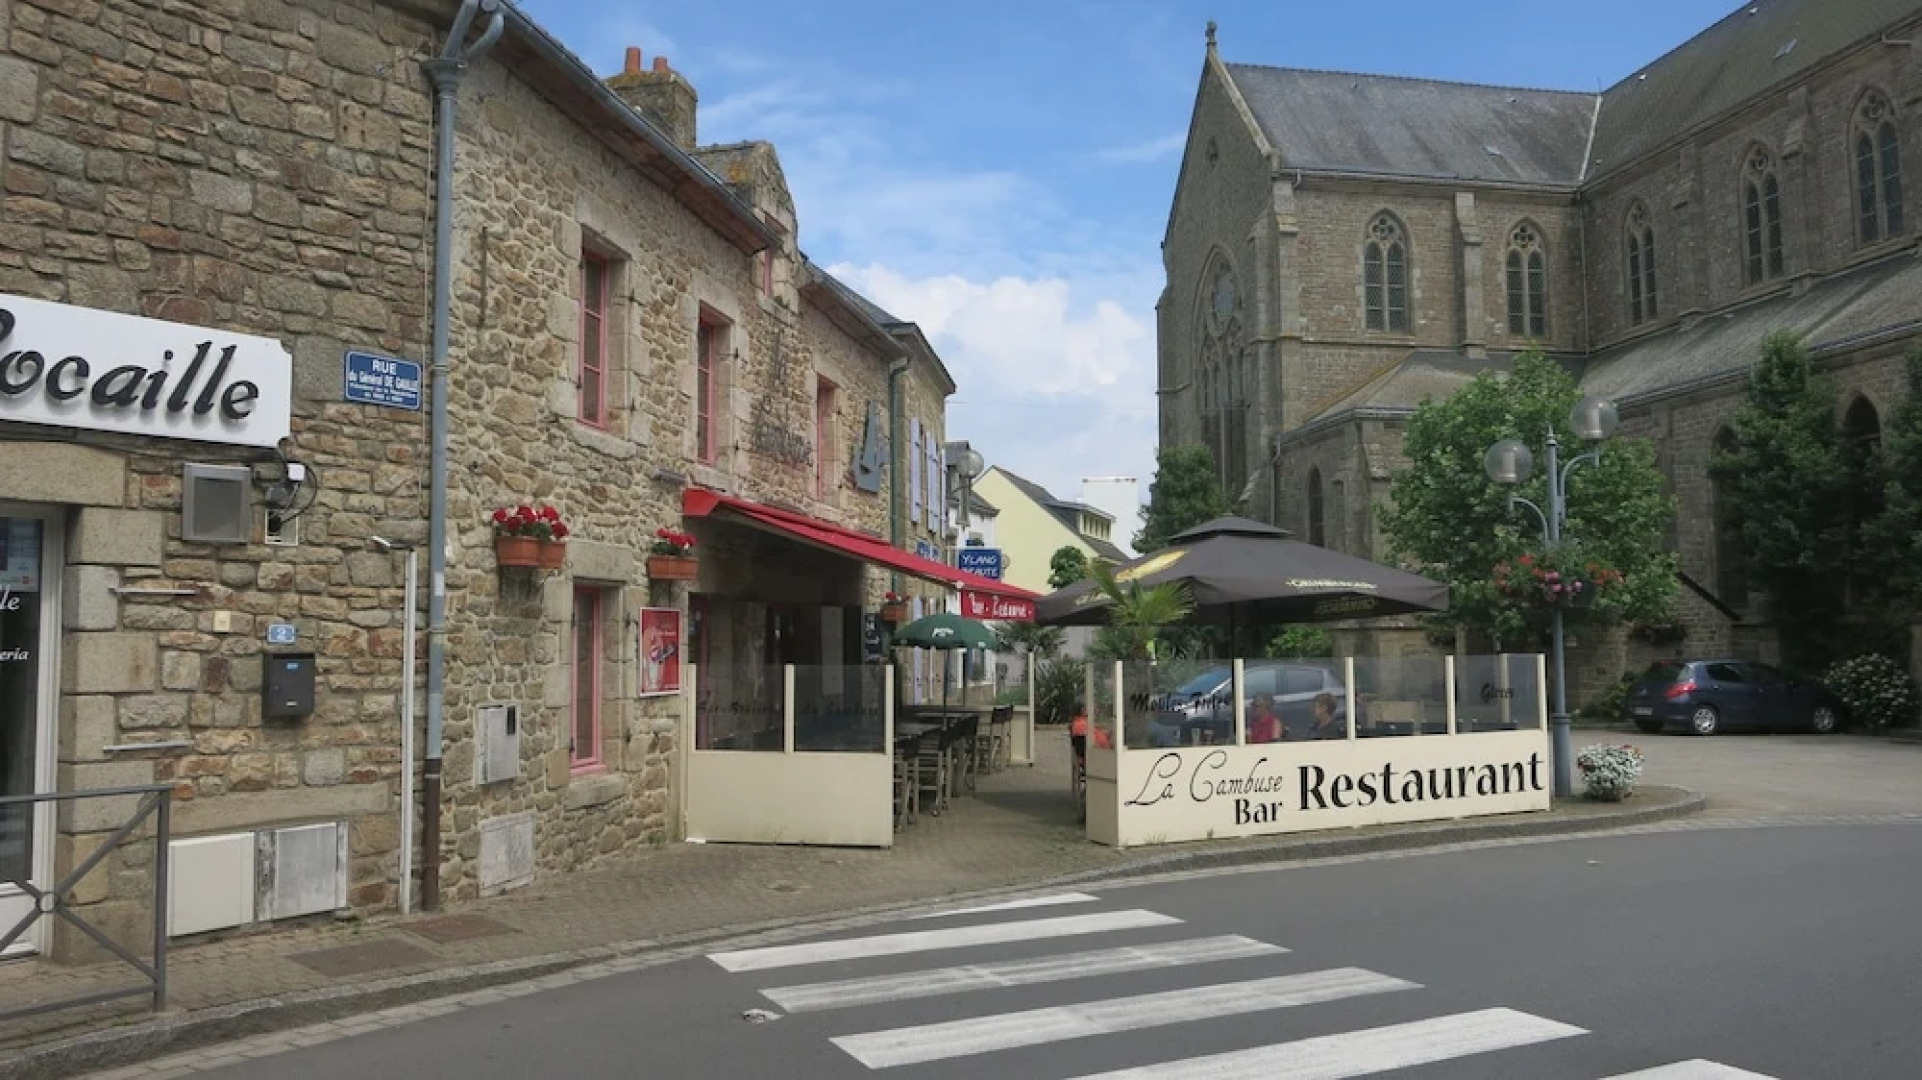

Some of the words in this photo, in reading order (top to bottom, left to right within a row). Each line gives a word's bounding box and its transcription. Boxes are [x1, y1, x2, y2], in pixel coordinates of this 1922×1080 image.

[372, 359, 397, 375] RUE
[276, 626, 287, 640] 2
[1124, 752, 1183, 807] La
[1190, 749, 1283, 802] Cambuse
[1297, 752, 1547, 811] Restaurant
[1234, 798, 1283, 825] Bar
